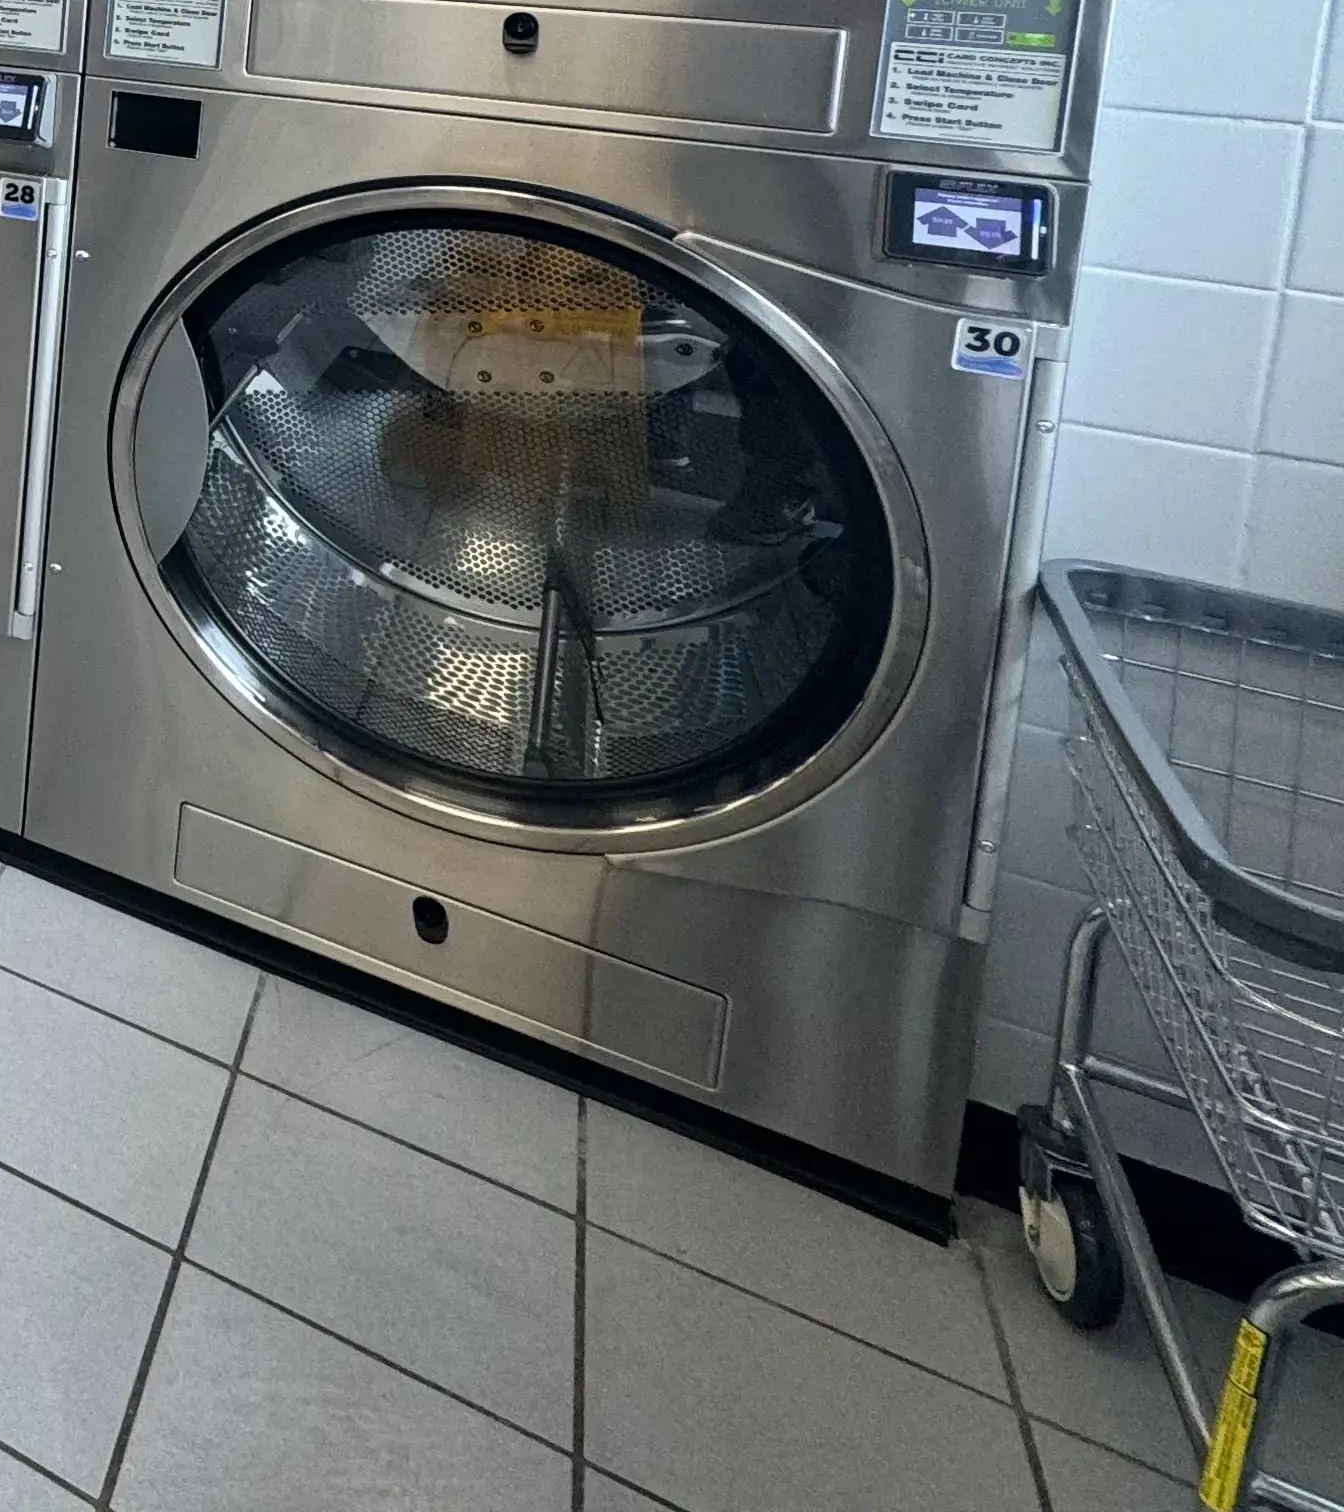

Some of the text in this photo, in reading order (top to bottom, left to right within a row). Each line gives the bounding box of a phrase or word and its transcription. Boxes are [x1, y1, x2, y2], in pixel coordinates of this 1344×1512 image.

[908, 68, 934, 76] Load
[936, 70, 981, 80] Machine
[997, 75, 1028, 84] Close
[1031, 78, 1058, 86] Door
[906, 83, 941, 91] Select
[944, 86, 1014, 98] Temperature
[904, 98, 943, 108] Swipe
[948, 102, 979, 111] Card
[902, 113, 931, 123] Press
[935, 116, 962, 125] Start
[965, 120, 1003, 129] Button
[5, 183, 35, 204] 28
[965, 326, 1021, 357] 30
